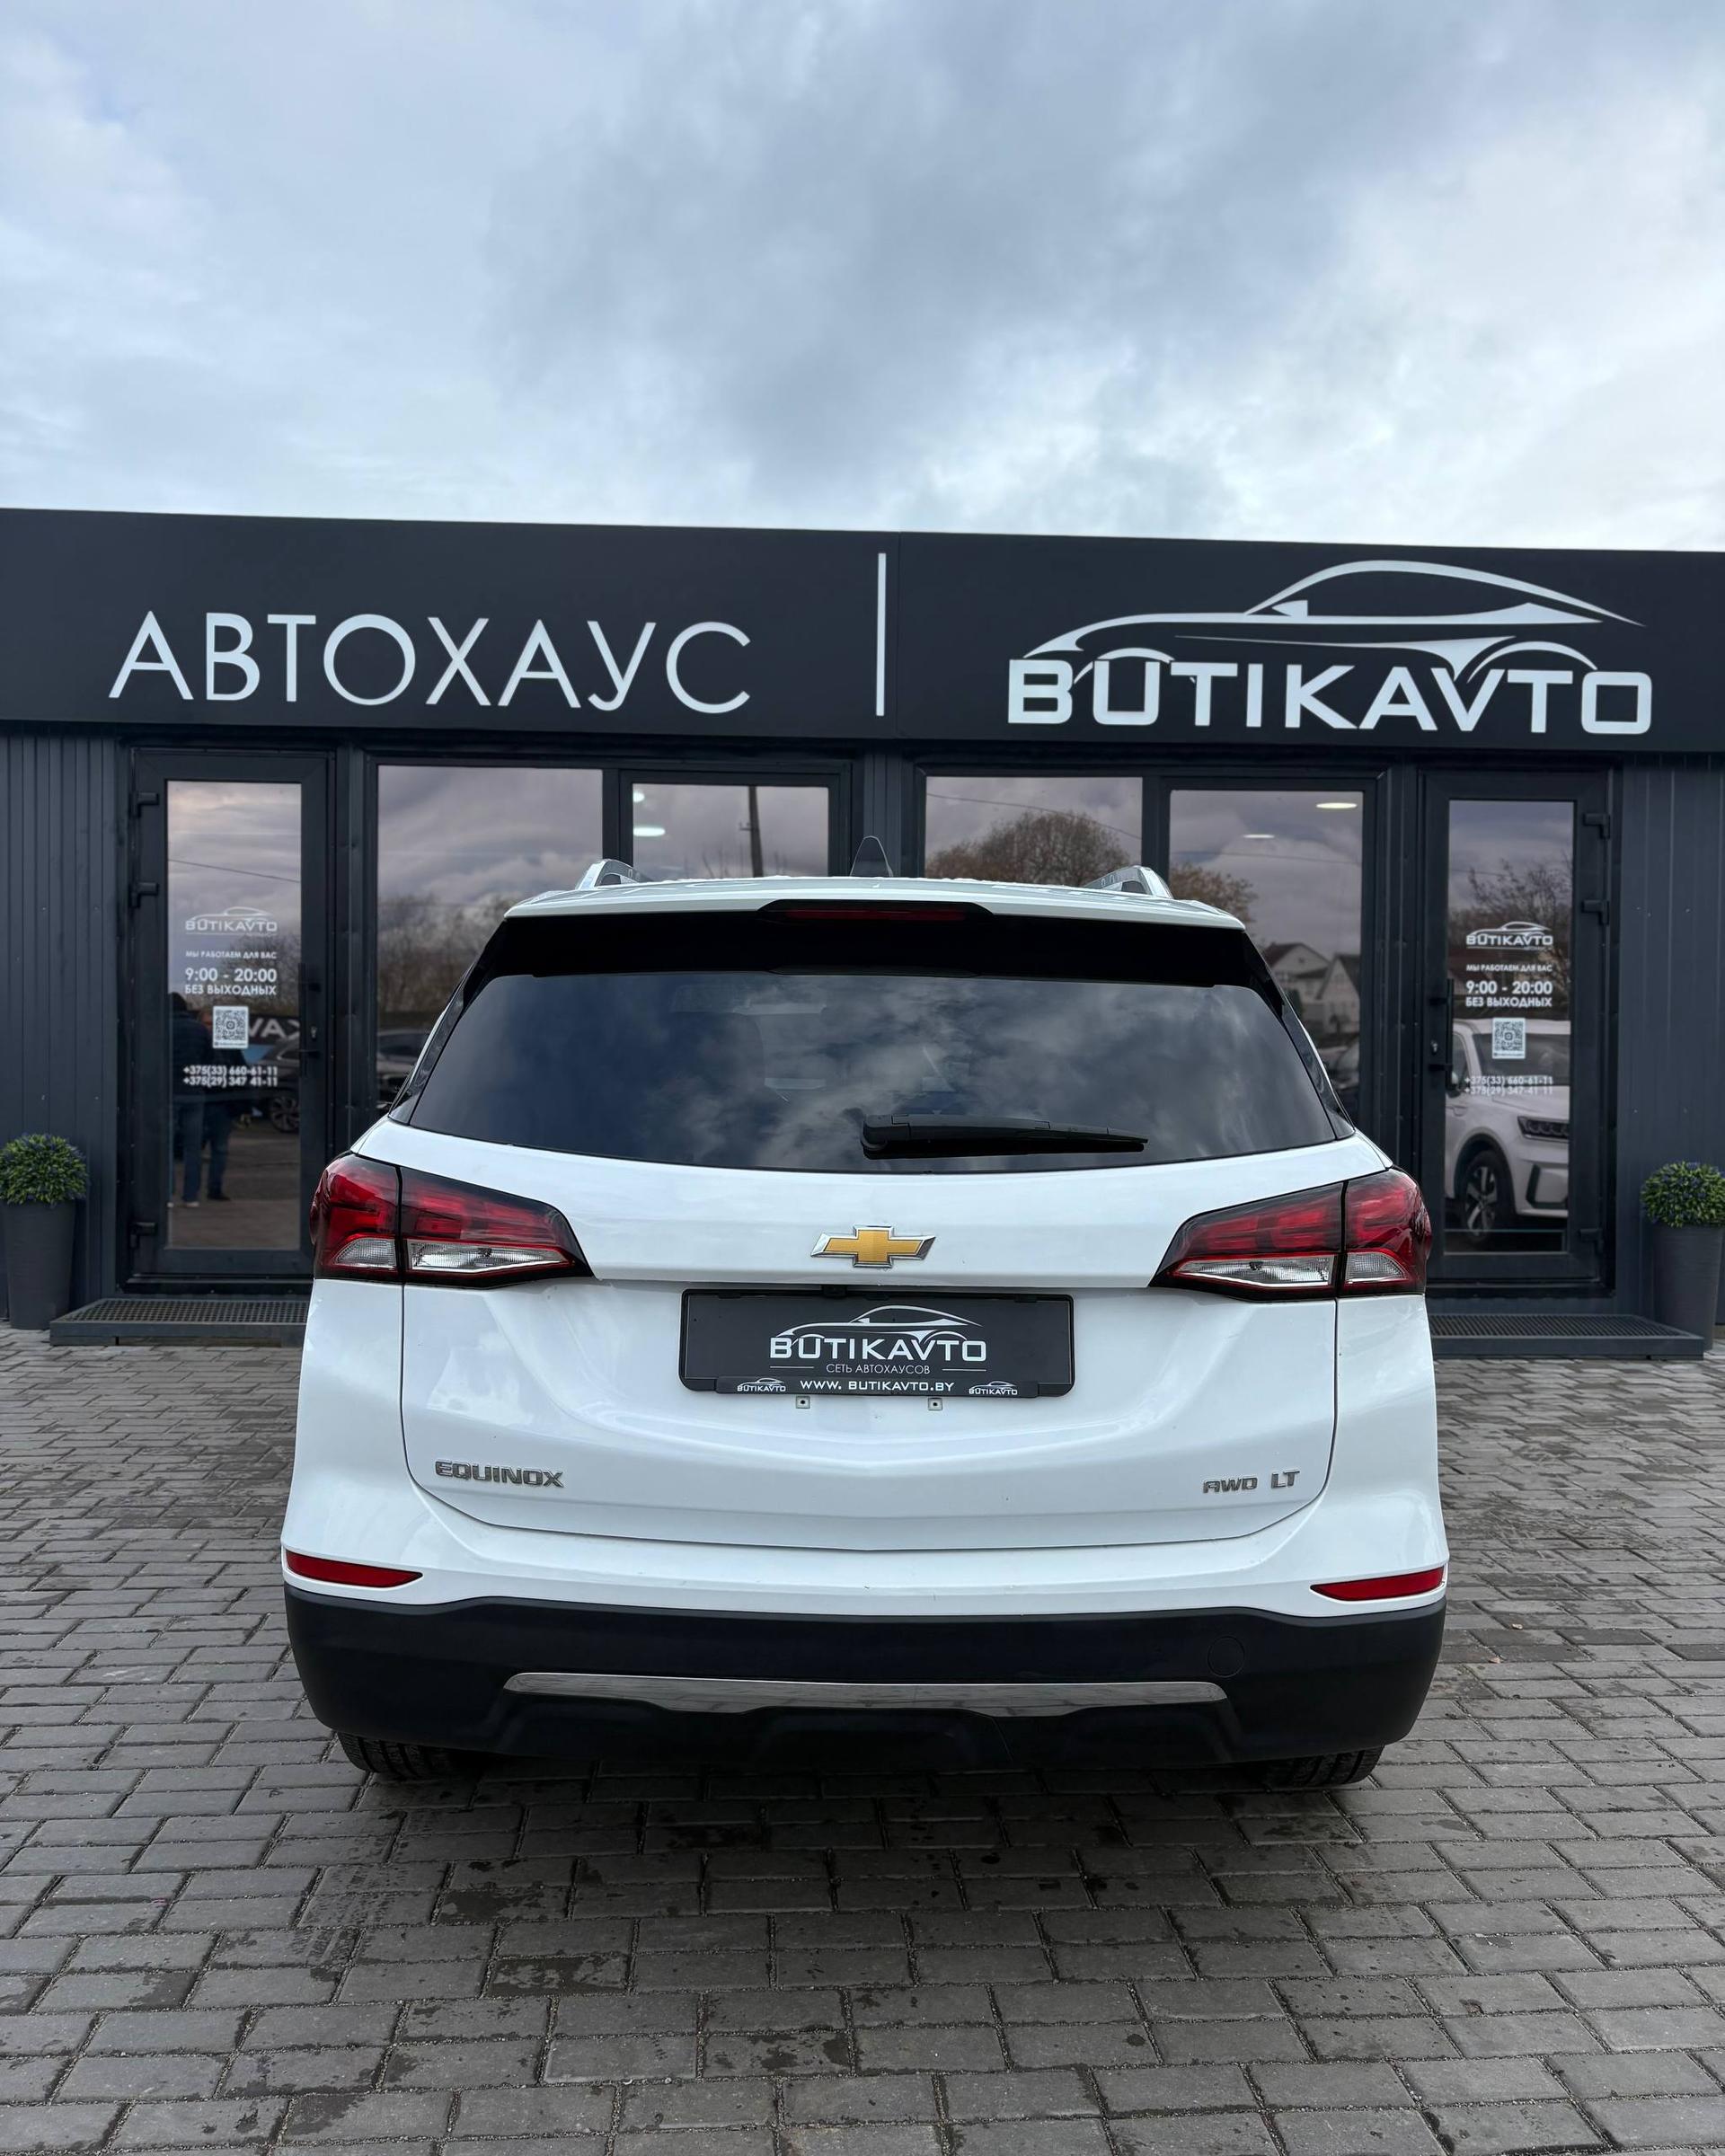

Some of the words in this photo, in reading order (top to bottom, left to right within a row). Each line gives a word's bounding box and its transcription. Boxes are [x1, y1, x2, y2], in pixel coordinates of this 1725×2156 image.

[108, 610, 751, 714] АВТОХАУС
[1007, 658, 1653, 735] BUTIKAVTO
[185, 920, 278, 932] BUTIKAVTO
[1465, 934, 1553, 946] BUTIKAVTO
[200, 950, 242, 959] РАБОТАЕМ
[243, 951, 259, 959] ДЛЯ
[260, 951, 278, 959] ВАС
[1520, 964, 1536, 972] ДЛЯ
[185, 968, 217, 982] 9:00
[234, 968, 278, 983] 20:00
[184, 984, 205, 994] БЕЗ
[207, 985, 277, 996] ВЫХОДНЫХ
[1466, 980, 1498, 994] 9:00
[1512, 981, 1553, 994] 20:00
[1465, 996, 1484, 1007] БЕЗ
[1486, 996, 1552, 1008] ВЫХОДНЫХ
[183, 1065, 227, 1077] +375(33)
[229, 1066, 279, 1076] 660-61-11
[183, 1076, 227, 1088] +375(29)
[770, 1338, 987, 1362] BUTIKAVTO
[826, 1364, 853, 1374] СЕТЬ
[854, 1364, 931, 1374] АВТОХАУСОВ
[737, 1384, 787, 1392] BUTIKAVTO
[969, 1387, 1019, 1396] BUTIKAVTO
[435, 1459, 565, 1489] EQUINOX
[1202, 1475, 1259, 1494] AWD
[1270, 1469, 1301, 1489] LT
